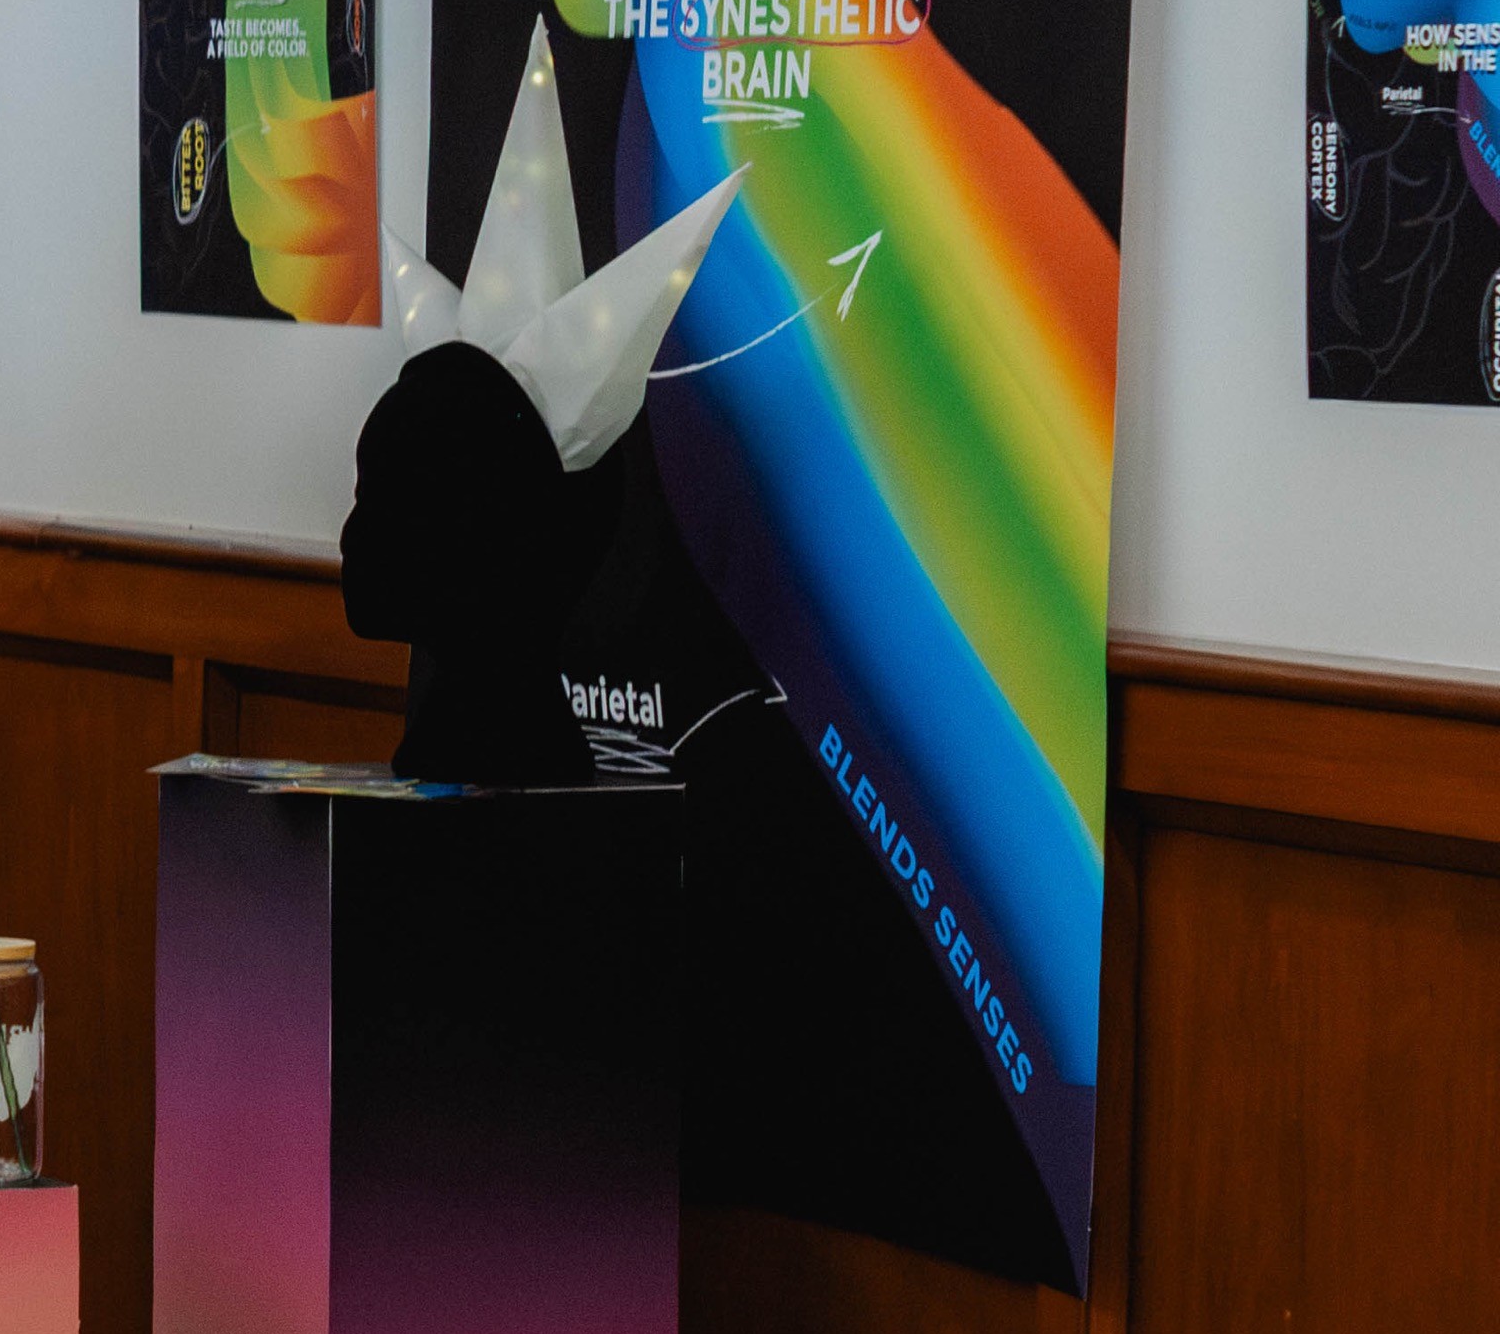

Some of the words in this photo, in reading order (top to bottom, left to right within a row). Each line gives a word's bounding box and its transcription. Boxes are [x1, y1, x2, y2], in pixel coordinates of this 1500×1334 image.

[207, 40, 216, 59] A
[217, 39, 248, 59] FIELD
[250, 39, 265, 59] OF
[210, 19, 243, 38] TASTE
[1406, 24, 1450, 48] HOW
[702, 49, 812, 100] BRAIN
[1438, 50, 1457, 72] IN
[1462, 48, 1497, 72] THE
[1382, 86, 1423, 102] Parietal
[180, 126, 192, 212] BITTER
[194, 120, 205, 191] ROOT
[1311, 121, 1323, 201] CORTEX
[1325, 121, 1337, 214] SENSORY
[819, 722, 936, 909] BLENDS
[934, 906, 1035, 1095] SENSES
